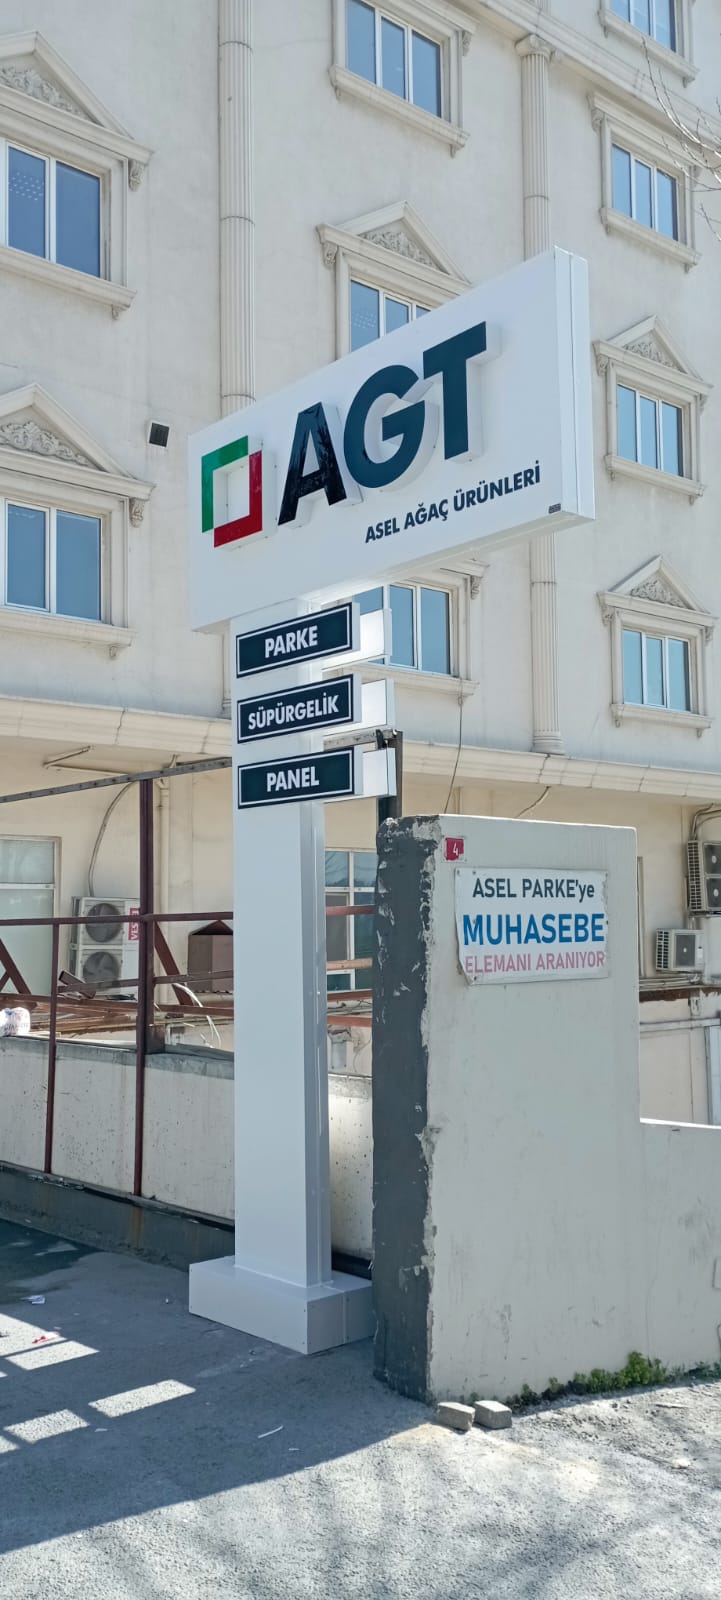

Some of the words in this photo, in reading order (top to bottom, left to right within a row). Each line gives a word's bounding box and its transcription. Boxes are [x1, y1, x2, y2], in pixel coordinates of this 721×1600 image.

[278, 321, 486, 526] AGT
[365, 517, 400, 543] ASEL
[404, 499, 449, 529] AĞAÇ
[453, 460, 541, 512] ÜRÜNLERİ
[265, 625, 318, 658] PARKE
[248, 692, 339, 730] SÜPÜRGELİK
[266, 766, 320, 792] PANEL
[452, 842, 459, 856] 4
[472, 878, 517, 898] ASEL
[522, 878, 595, 903] PARKE'ye
[463, 913, 605, 946] MUHASEBE
[465, 954, 531, 974] ELEMANI
[536, 951, 606, 970] ARANIYOR
